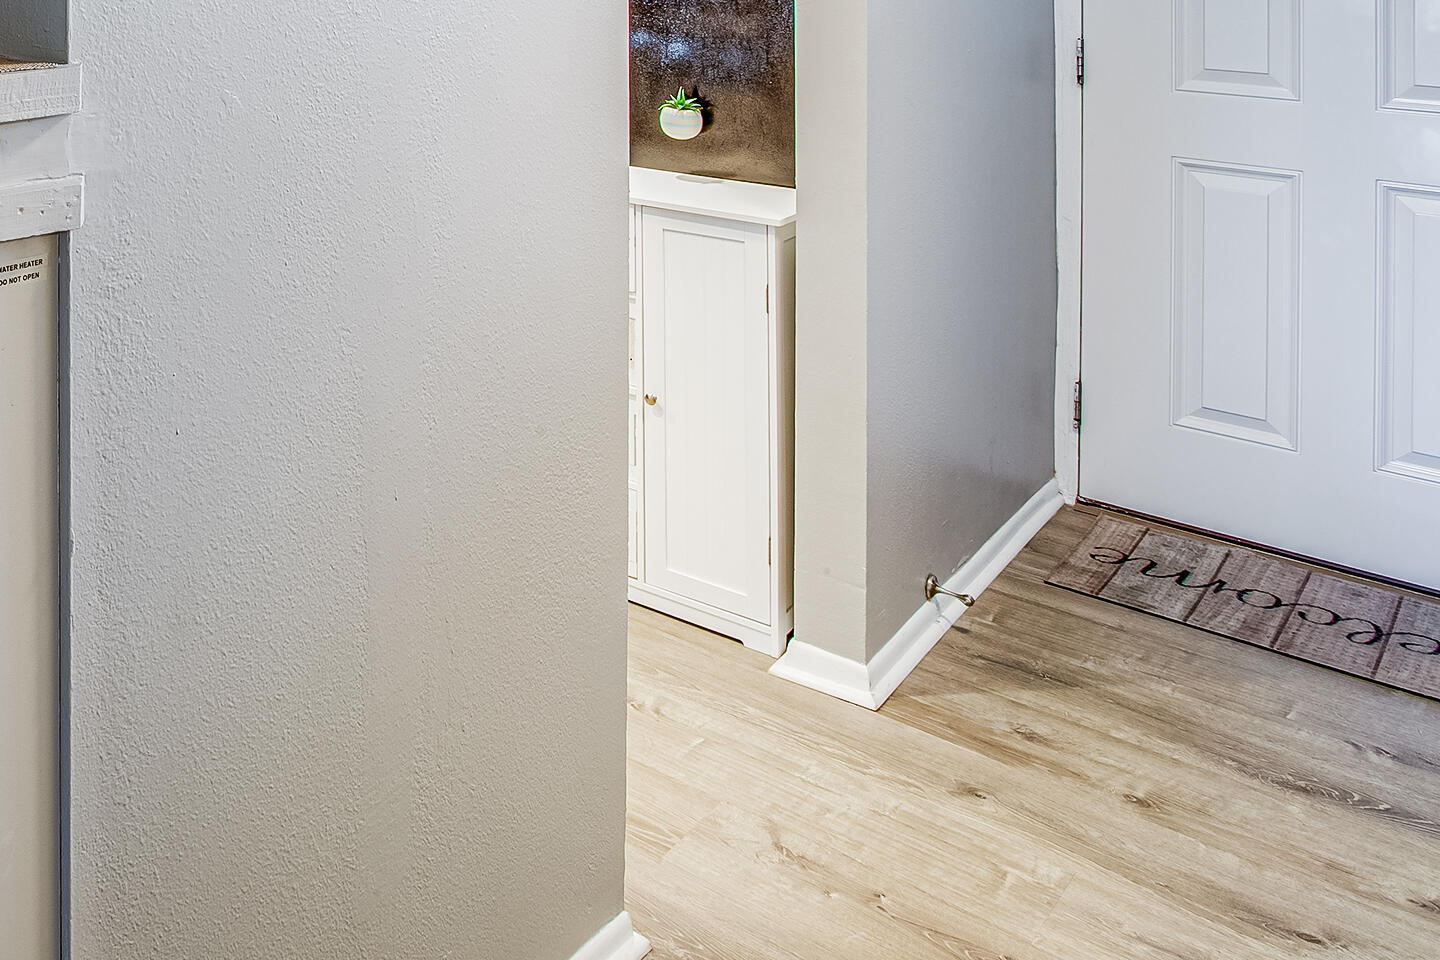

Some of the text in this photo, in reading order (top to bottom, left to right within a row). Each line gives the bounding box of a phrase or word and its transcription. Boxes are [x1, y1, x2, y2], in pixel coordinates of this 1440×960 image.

[19, 259, 43, 269] HEATER
[9, 276, 21, 284] NOT
[23, 272, 40, 281] OPEN
